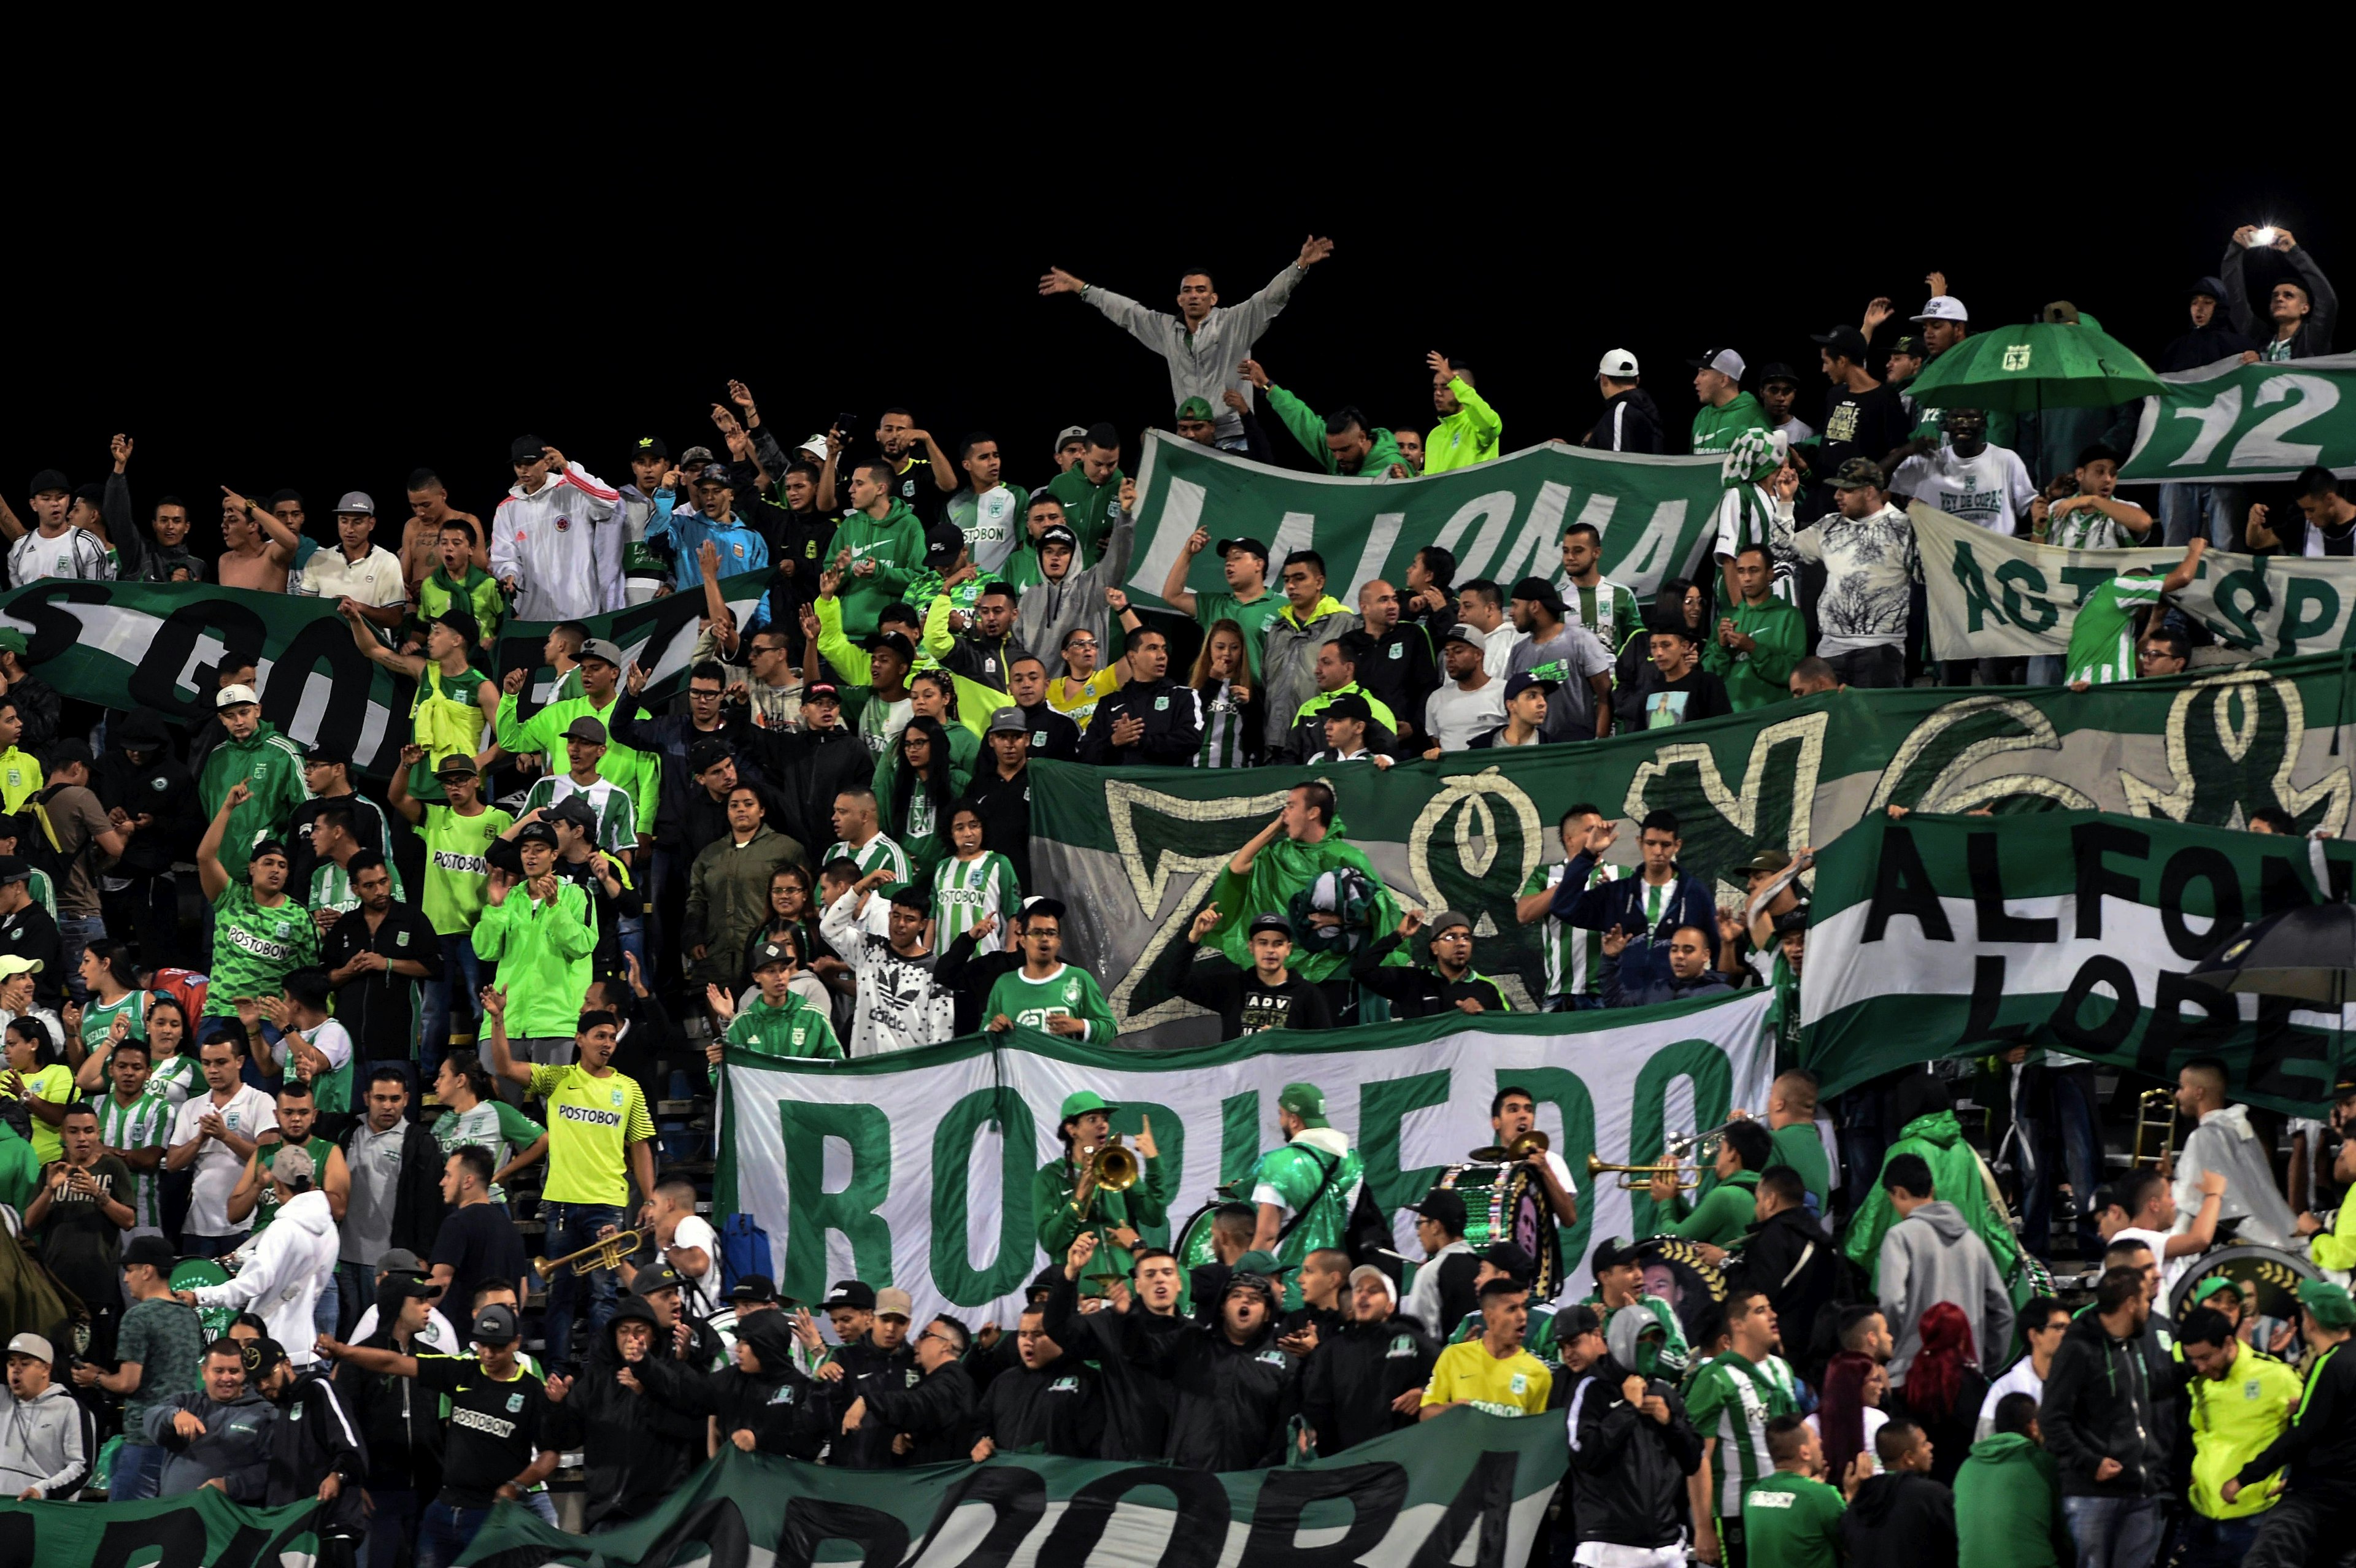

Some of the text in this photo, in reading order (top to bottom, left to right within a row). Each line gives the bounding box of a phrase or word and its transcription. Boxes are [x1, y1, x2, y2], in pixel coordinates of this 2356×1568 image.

[1940, 489, 2004, 512] REY DE COPAS
[1065, 703, 1098, 720] OBON
[228, 926, 288, 959] POSTOBON
[1248, 994, 1288, 1010] ADV
[142, 1079, 168, 1094] BON
[559, 1105, 621, 1128] POSTOBON
[452, 1407, 511, 1438] POSTOBON
